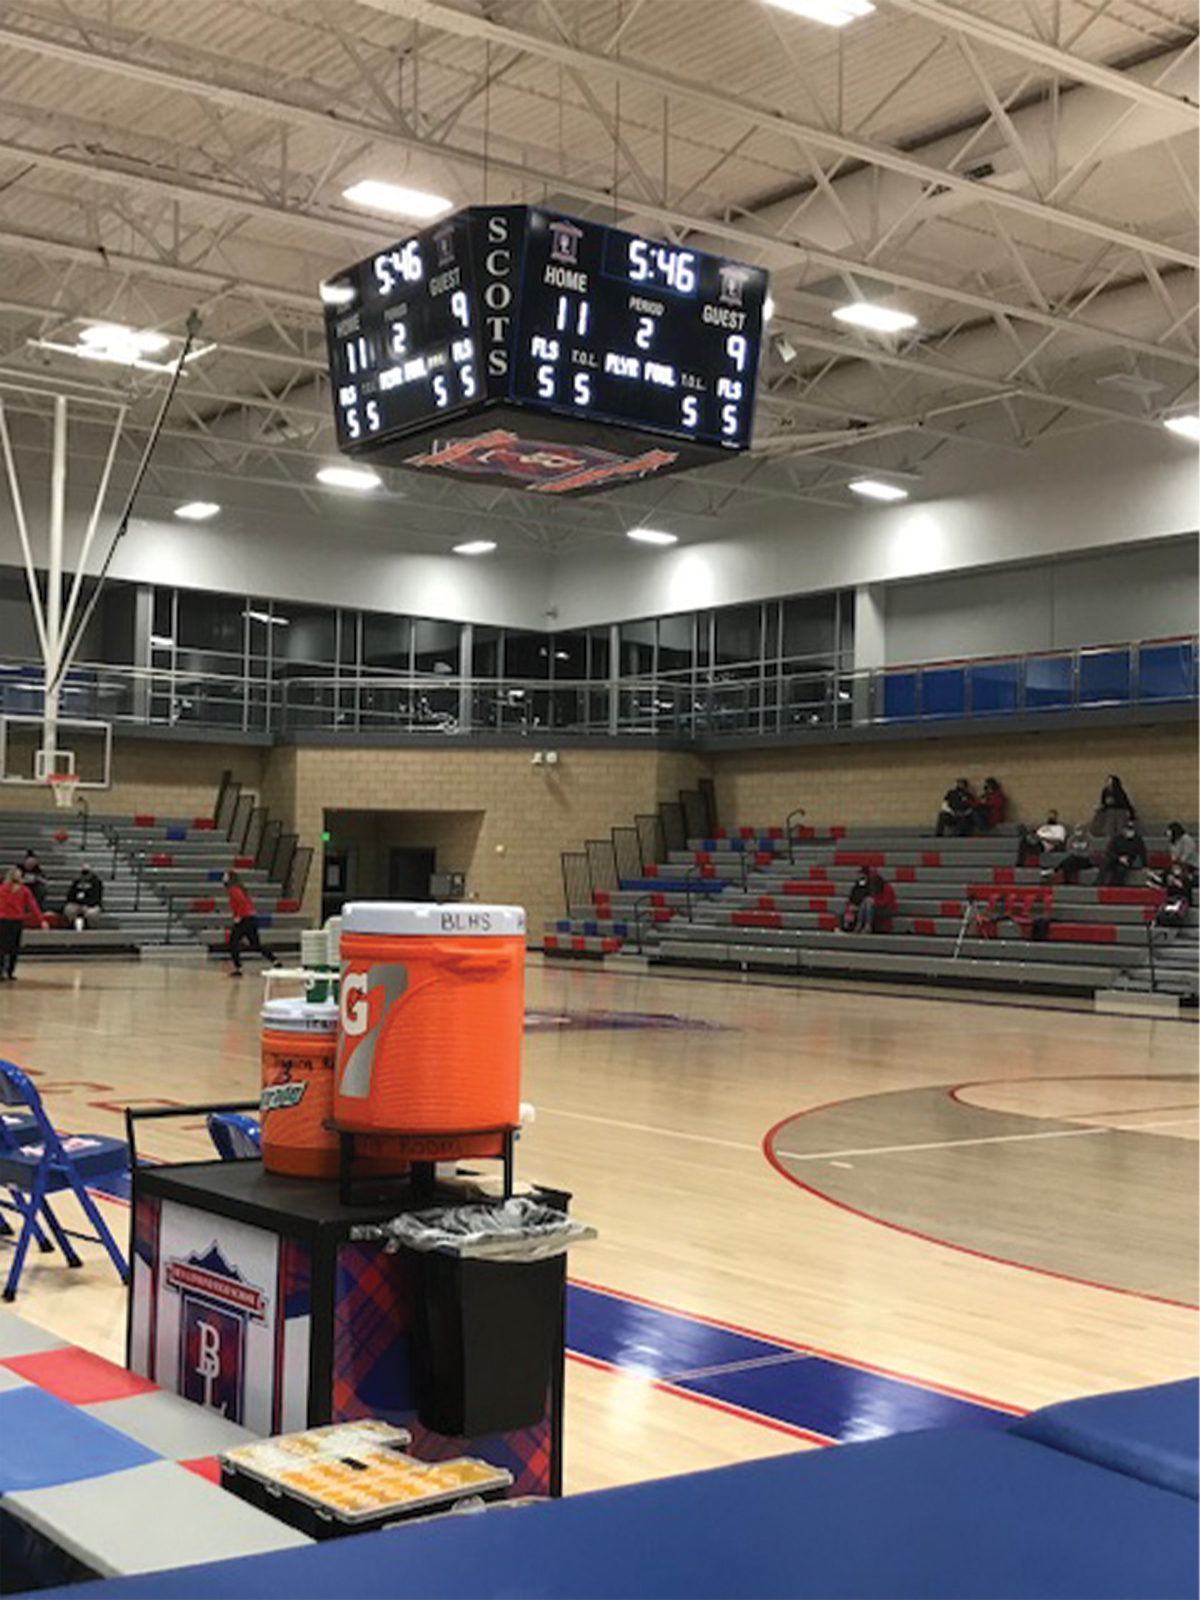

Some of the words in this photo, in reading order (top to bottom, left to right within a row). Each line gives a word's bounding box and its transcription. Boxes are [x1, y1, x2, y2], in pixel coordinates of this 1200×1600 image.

[374, 241, 422, 294] 5:46
[544, 266, 588, 293] HOME
[628, 240, 695, 293] 5:46
[429, 268, 461, 297] GUEST
[485, 216, 511, 376] SCOTS
[451, 293, 469, 328] 9
[556, 298, 589, 336] 11
[629, 298, 665, 317] PERIOD
[702, 306, 746, 331] GUEST
[393, 324, 406, 353] 2
[636, 319, 654, 349] 2
[347, 339, 368, 374] 11
[531, 338, 559, 361] FLS
[727, 336, 747, 372] 9
[433, 377, 448, 407] 5
[460, 367, 475, 397] 5
[537, 366, 554, 398] 5
[573, 373, 591, 404] 5
[717, 379, 742, 400] FLS
[347, 410, 360, 438] 5
[366, 403, 380, 431] 5
[682, 397, 698, 427] 5
[722, 406, 738, 435] 5
[441, 911, 492, 932] BLHS
[342, 972, 369, 1036] G
